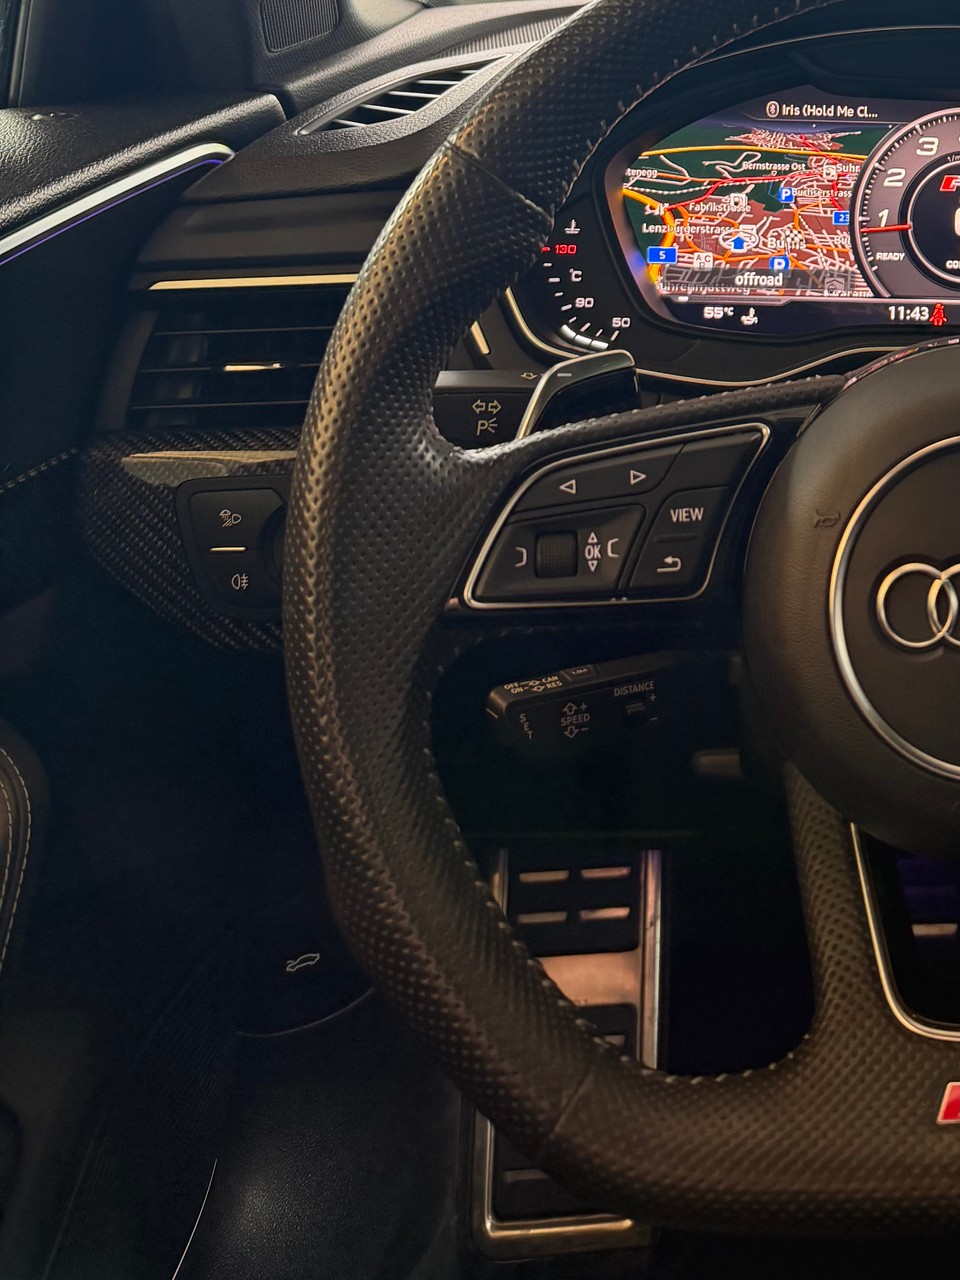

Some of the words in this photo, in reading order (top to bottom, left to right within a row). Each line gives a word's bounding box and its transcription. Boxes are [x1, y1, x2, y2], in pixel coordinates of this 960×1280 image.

[782, 104, 800, 116] Iris
[802, 104, 834, 117] (Hold
[837, 105, 854, 117] Me
[916, 137, 939, 155] 3
[625, 168, 658, 178] tenegg
[791, 162, 806, 171] Ost
[836, 163, 860, 173] Suhr
[883, 168, 906, 187] 2
[878, 209, 890, 227] 1
[554, 244, 577, 255] 130
[876, 252, 905, 261] READY
[735, 272, 783, 286] offroad
[575, 297, 594, 308] 90
[888, 306, 930, 321] 11:43
[612, 317, 631, 328] 50
[670, 507, 704, 522] VIEW
[584, 544, 602, 559] OK
[613, 680, 655, 697] DISTANCE
[561, 713, 590, 726] SPEED
